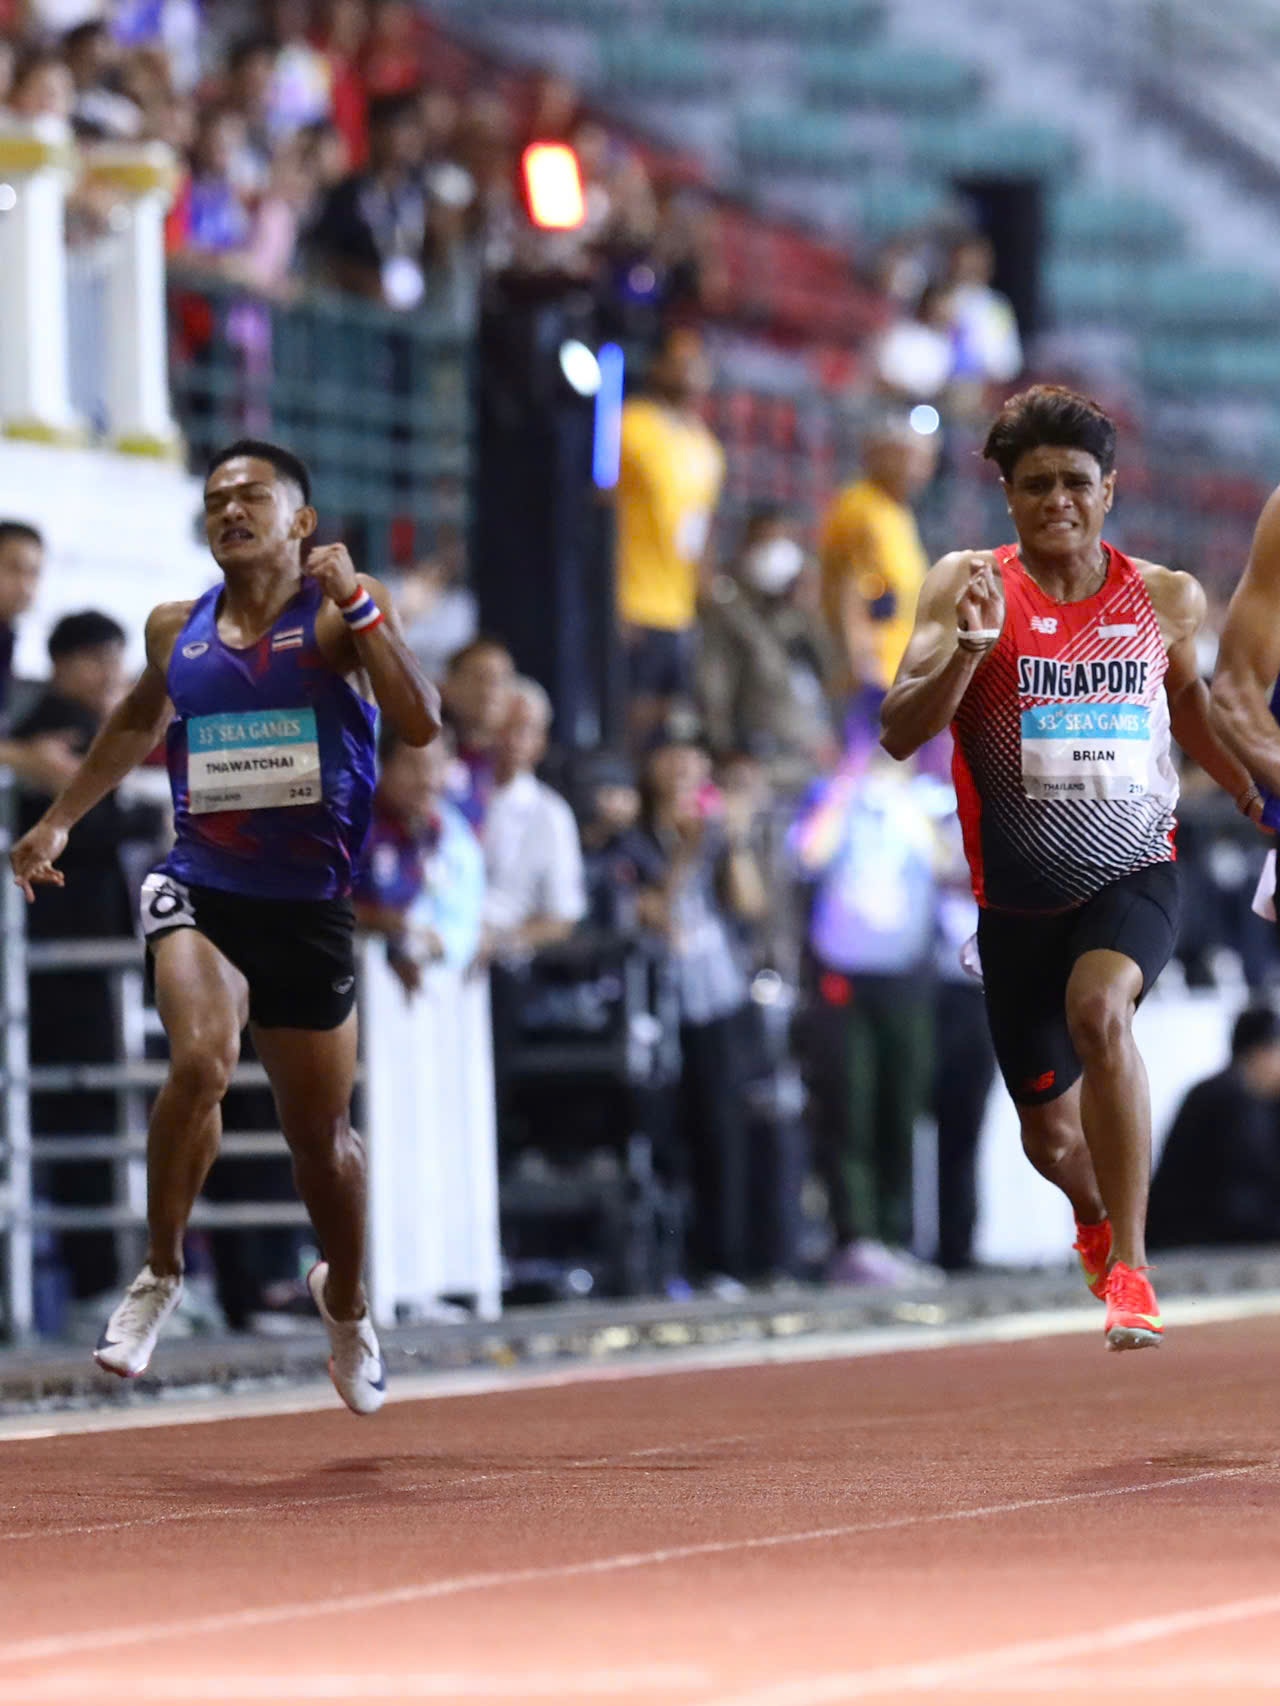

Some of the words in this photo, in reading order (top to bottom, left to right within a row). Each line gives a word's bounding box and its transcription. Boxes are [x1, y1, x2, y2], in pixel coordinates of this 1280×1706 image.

[1018, 656, 1149, 698] SINGAPORE
[219, 722, 245, 741] SEA
[249, 719, 300, 740] GAMES
[1065, 713, 1095, 730] SEA
[1098, 713, 1139, 732] GAMES
[1073, 750, 1115, 761] BRIAN
[205, 756, 294, 774] THAWATCHAI
[290, 787, 312, 798] 242
[1043, 782, 1086, 791] THAILAND
